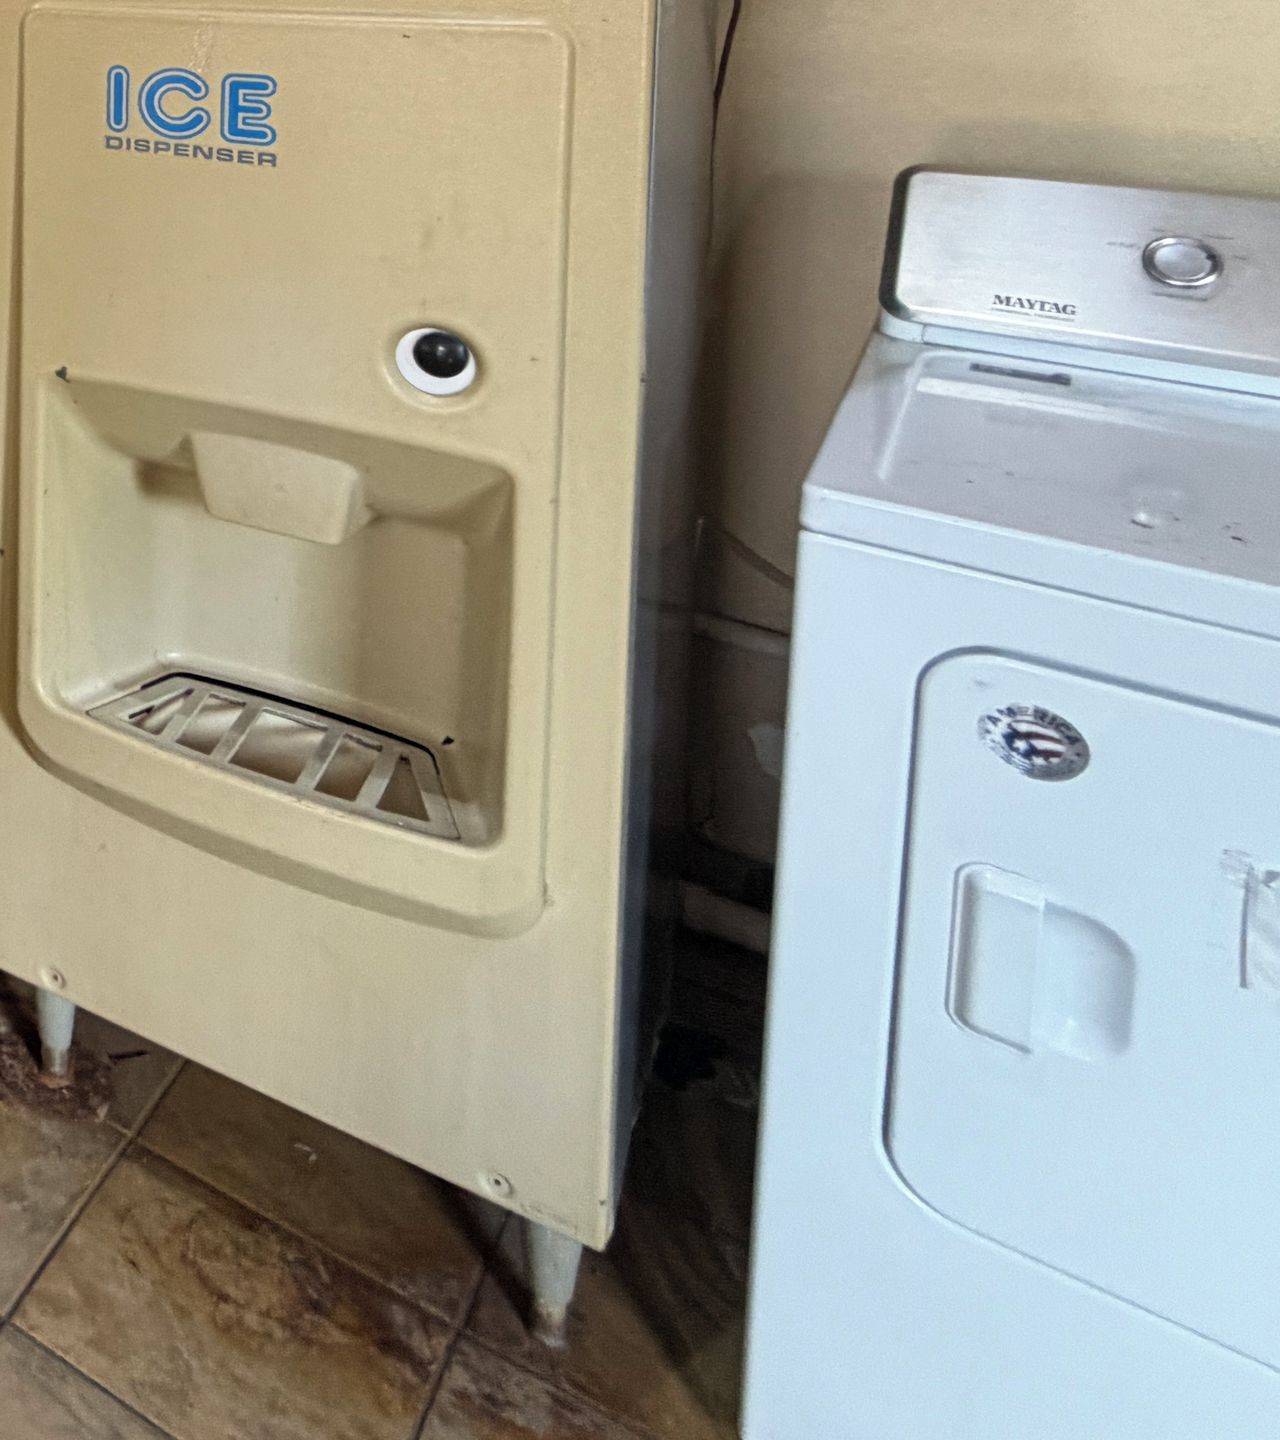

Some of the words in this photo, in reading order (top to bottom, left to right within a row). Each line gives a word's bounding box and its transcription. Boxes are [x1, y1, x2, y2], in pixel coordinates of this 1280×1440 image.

[105, 64, 278, 147] ICE
[104, 135, 278, 168] DISPENSER
[991, 293, 1077, 316] MAYTAG
